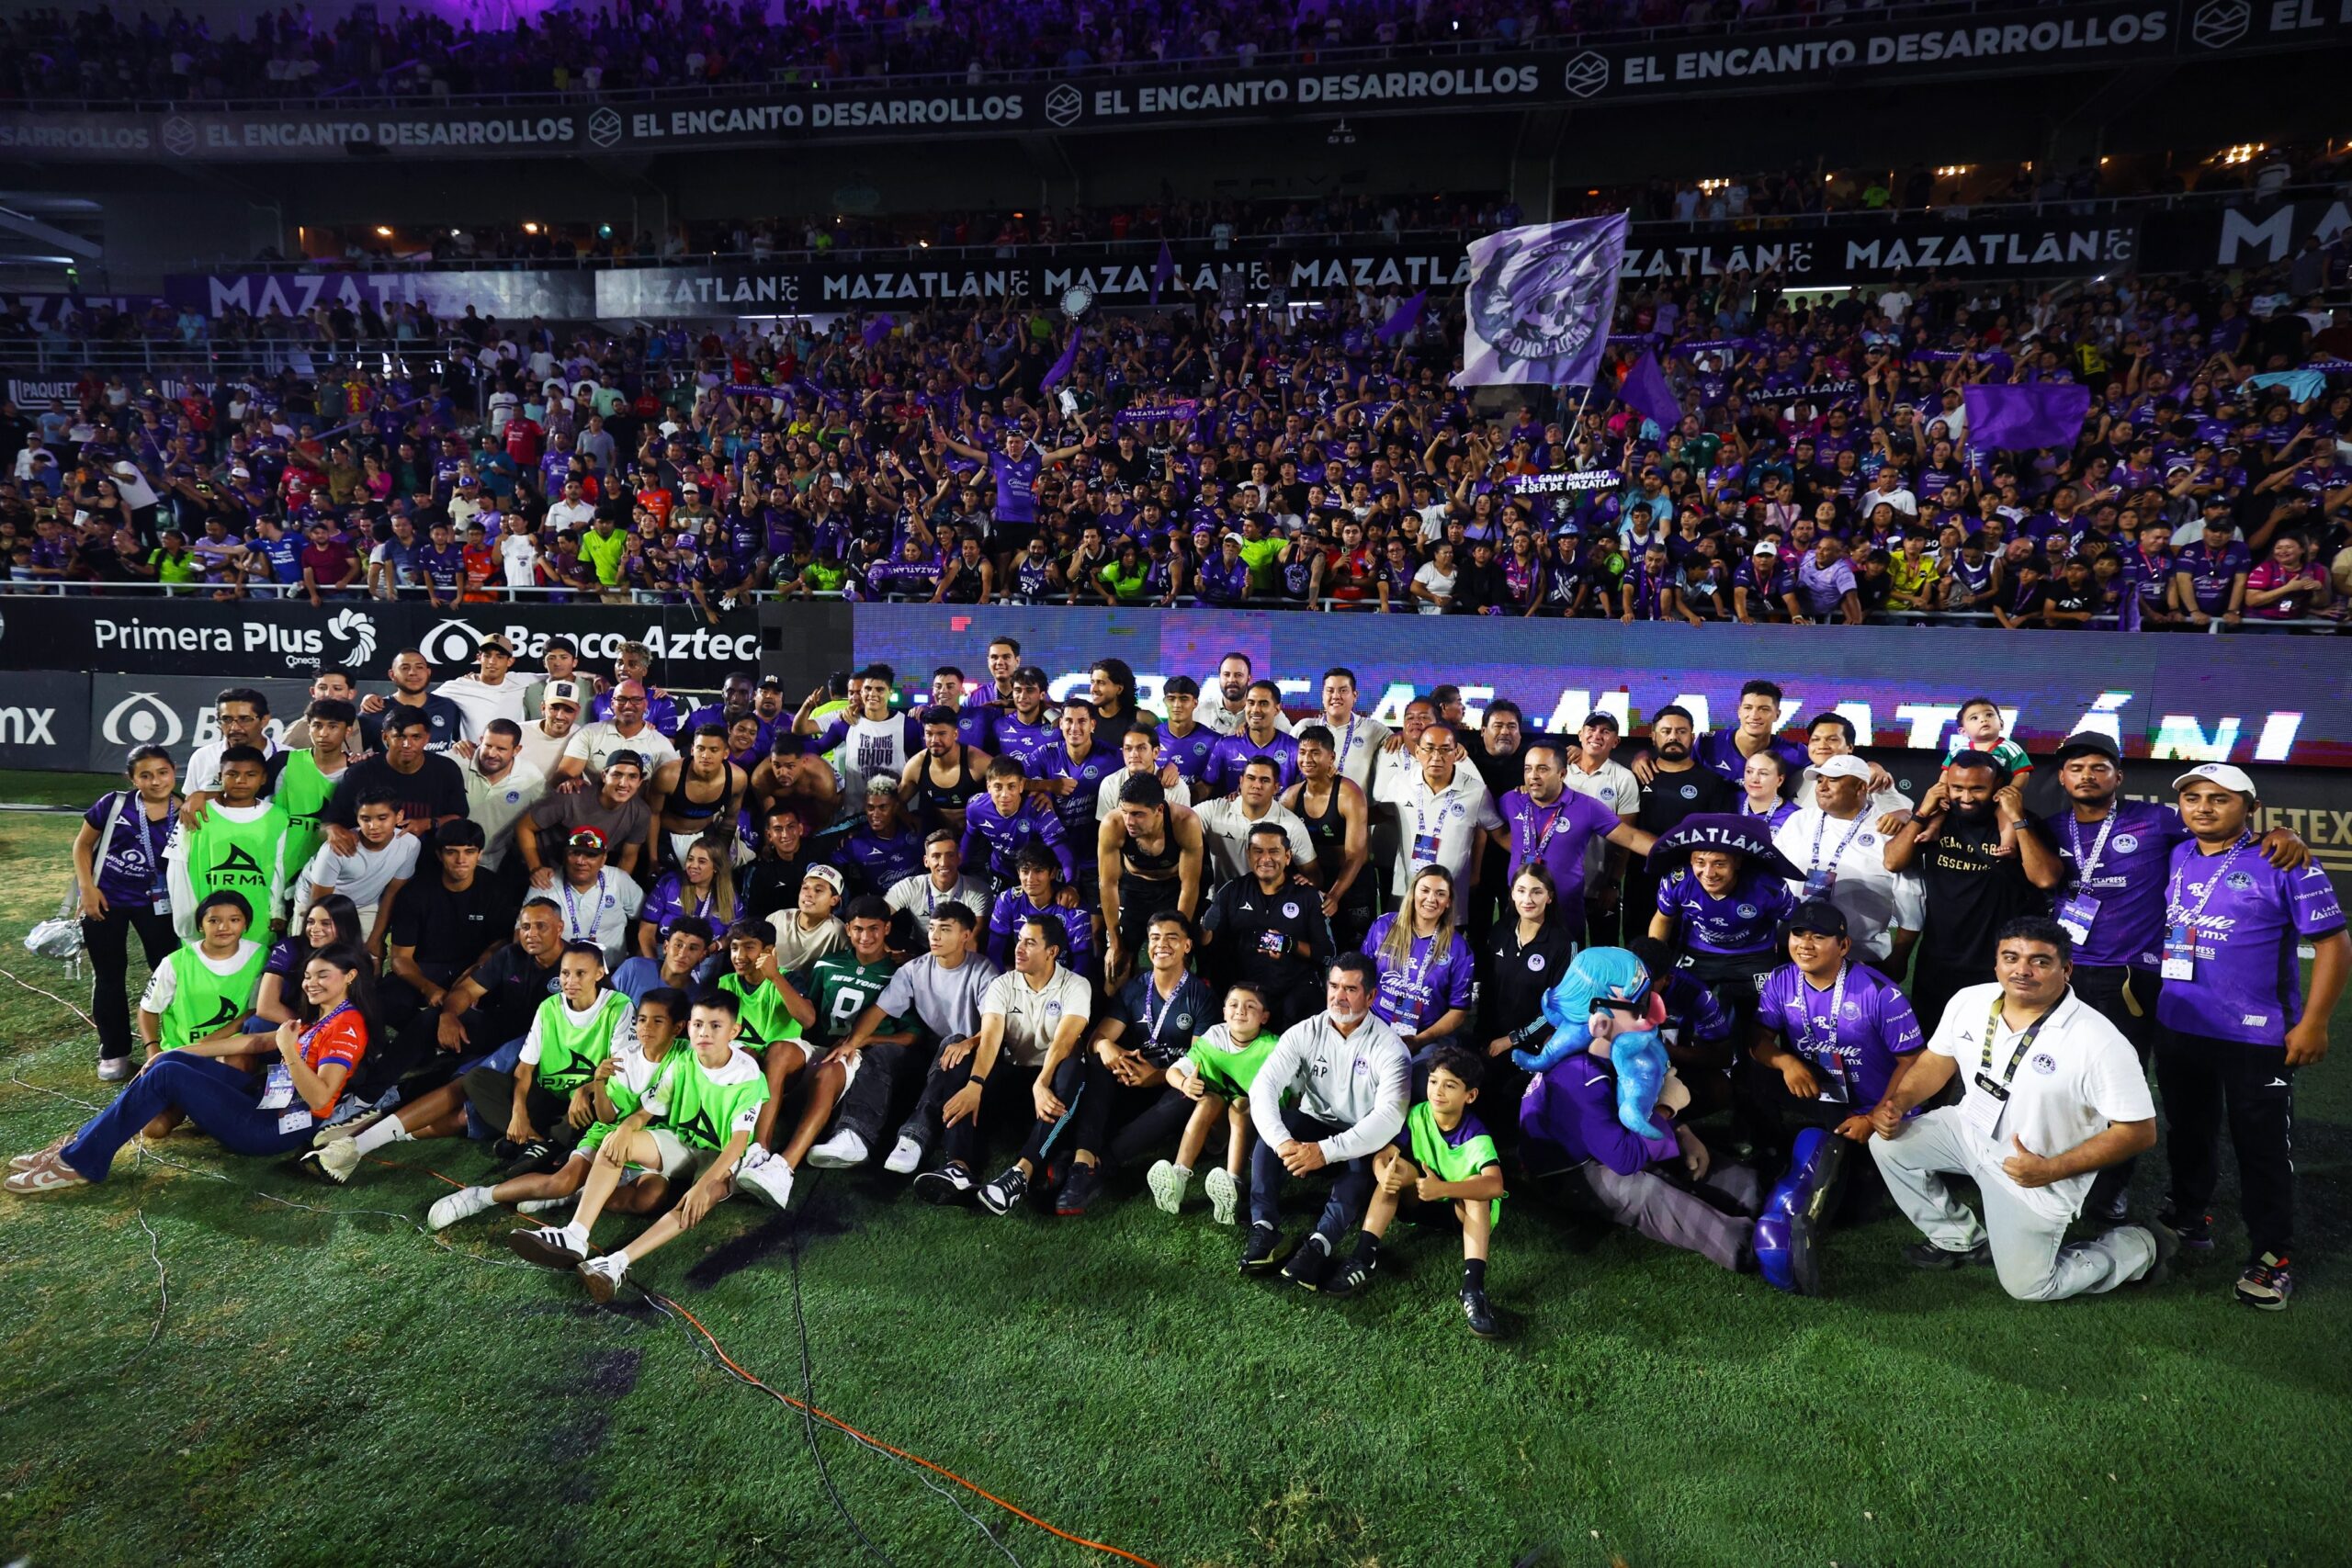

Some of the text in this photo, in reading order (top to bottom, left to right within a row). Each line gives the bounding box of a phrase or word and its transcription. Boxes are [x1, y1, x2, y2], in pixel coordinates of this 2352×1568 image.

[2269, 0, 2324, 30] EL
[1623, 12, 2166, 85] EL ENCANTO DESARROLLOS
[1095, 65, 1538, 116] EL ENCANTO DESARROLLOS
[207, 118, 573, 147] EL ENCANTO DESARROLLOS
[634, 96, 1023, 137] EL ENCANTO DESARROLLOS
[1619, 243, 1783, 278] ZATLÁN
[1846, 232, 2099, 270] MAZATLÁN
[823, 271, 1005, 301] MAZATLÁN
[1514, 478, 1620, 494] DE SER DE MAZATLAN
[1521, 469, 1610, 485] EL GRAN ORGULLO
[95, 617, 323, 654] Primera Plus
[640, 625, 762, 661] Aztec
[1661, 827, 1765, 854] AZATLÁN
[830, 974, 884, 990] NEW YORK
[830, 986, 865, 1037] 8
